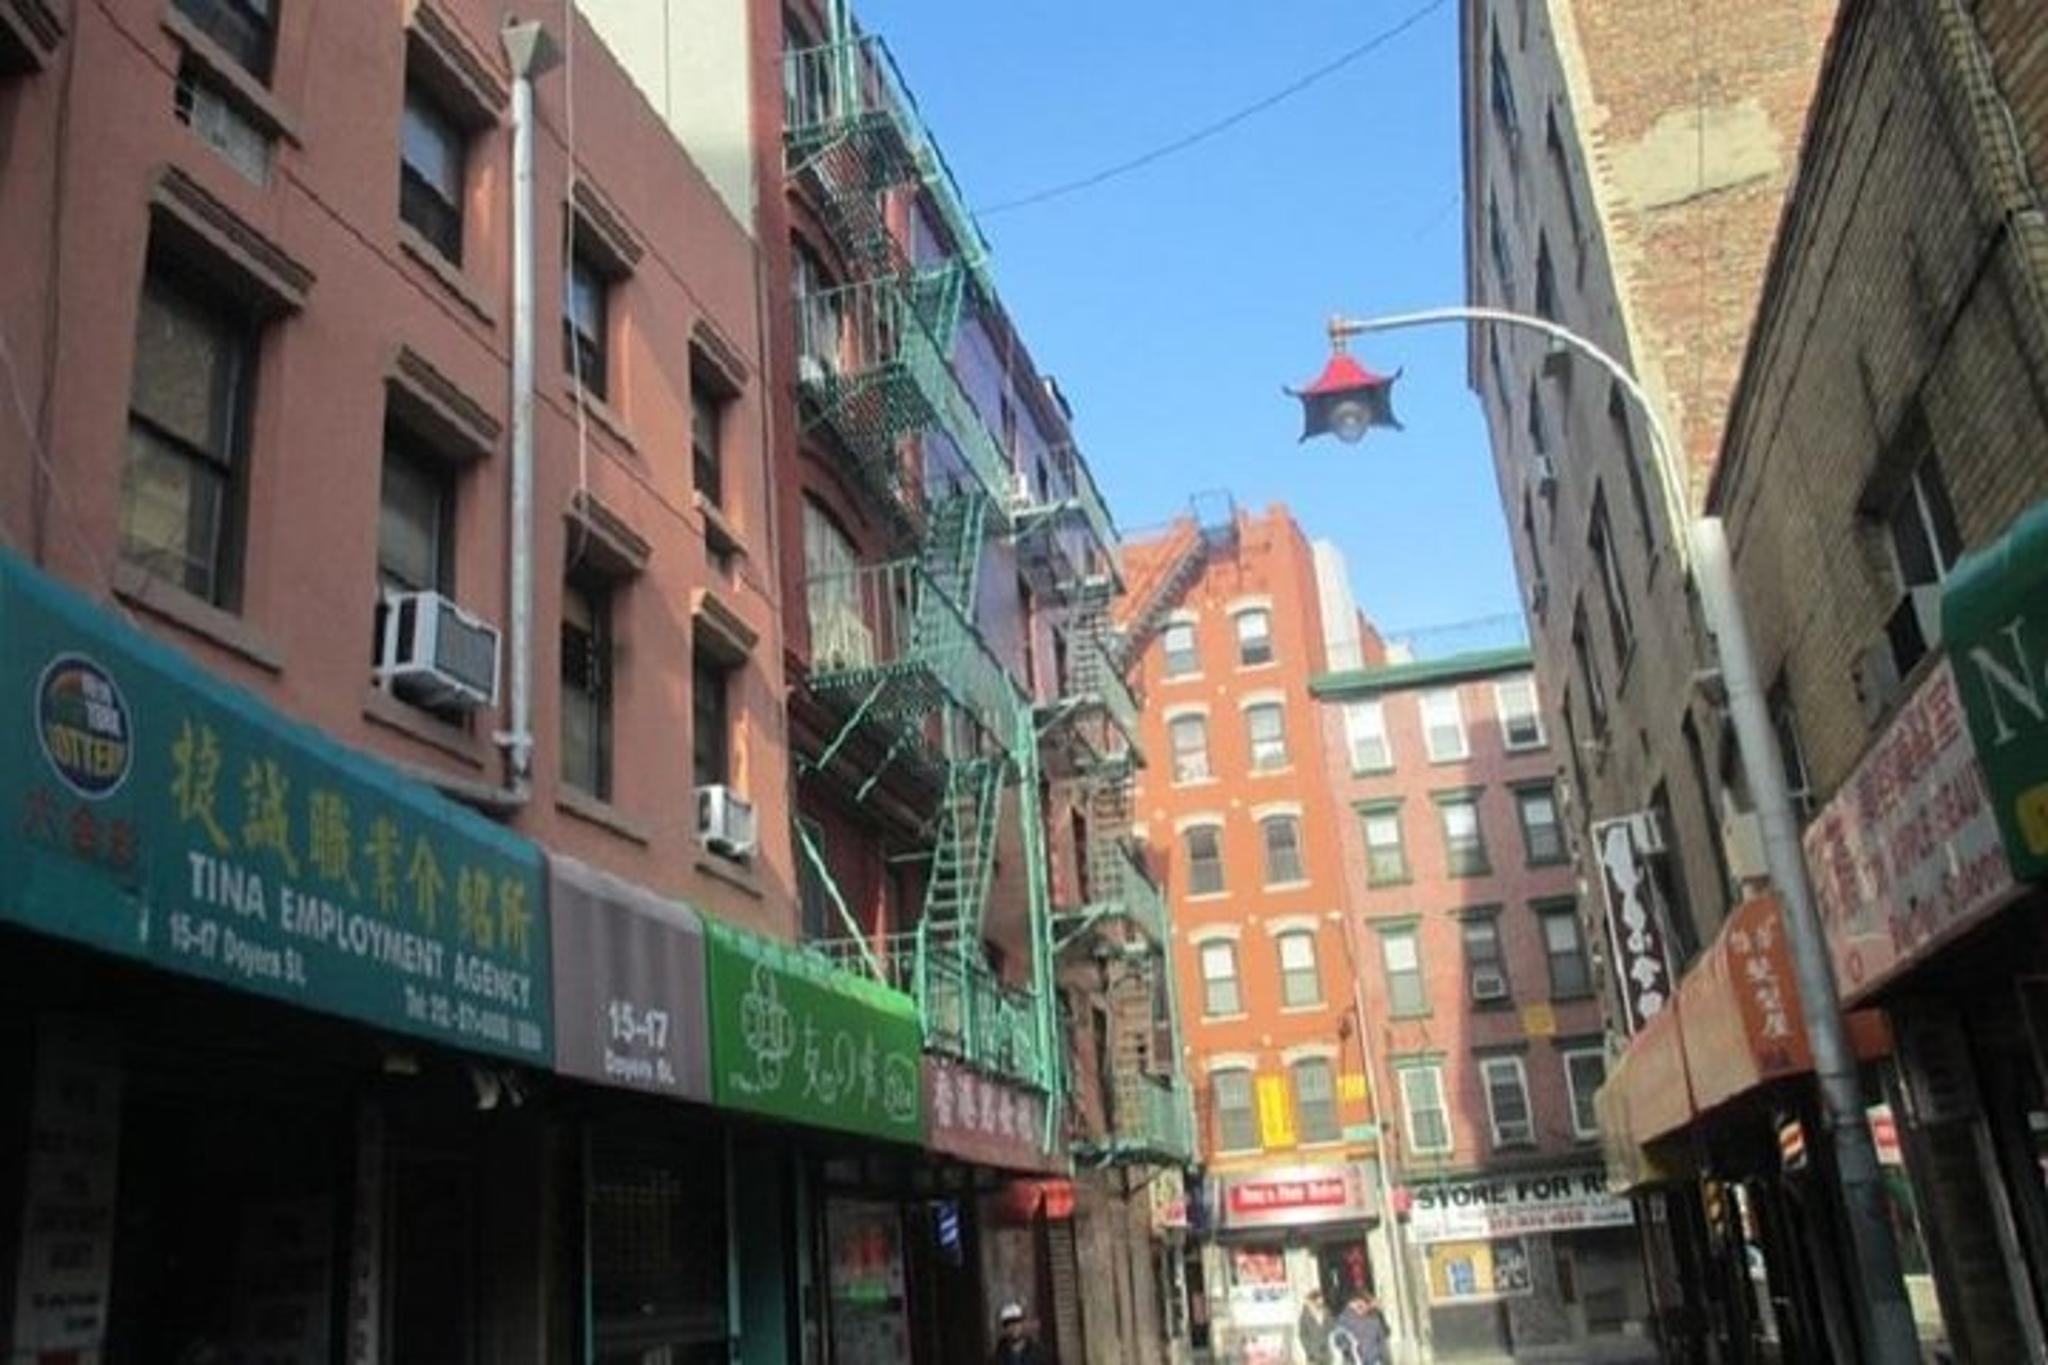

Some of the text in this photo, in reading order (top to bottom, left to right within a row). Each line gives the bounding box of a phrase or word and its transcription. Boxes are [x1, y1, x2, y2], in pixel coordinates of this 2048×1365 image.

[169, 911, 218, 959] 15-17
[224, 925, 282, 979] Doyers
[187, 851, 531, 1010] TINA EMPLOYMENT AGENCY
[608, 1001, 668, 1049] 15-17
[1419, 1180, 1508, 1210] STORE
[1516, 1176, 1572, 1203] FOR
